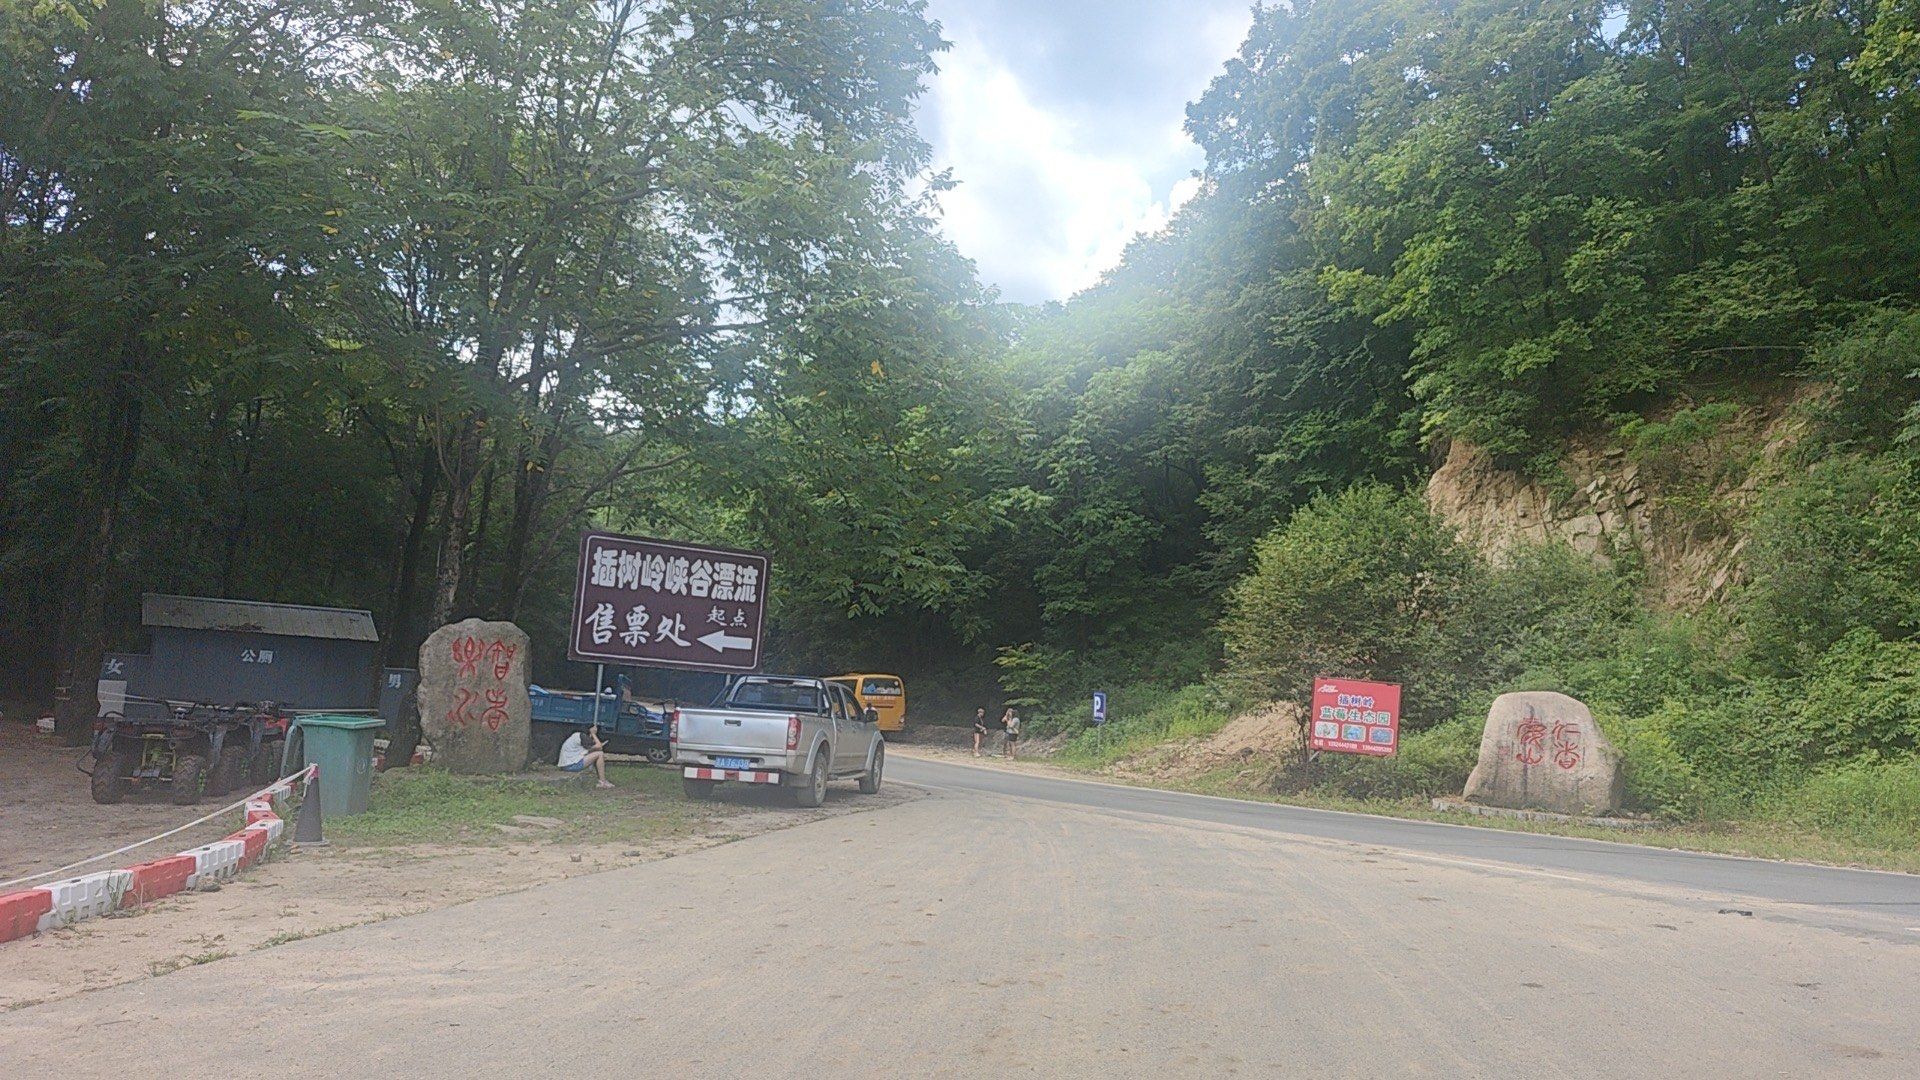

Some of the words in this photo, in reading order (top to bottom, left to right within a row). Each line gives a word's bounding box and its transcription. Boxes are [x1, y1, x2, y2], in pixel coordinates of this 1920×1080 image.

[591, 546, 759, 603] 插树岭峡谷漂流
[585, 603, 692, 648] 售票处
[705, 605, 748, 628] 起点
[105, 658, 125, 675] 女
[241, 649, 274, 664] 公厕
[388, 673, 402, 689] 男
[1094, 696, 1101, 717] P
